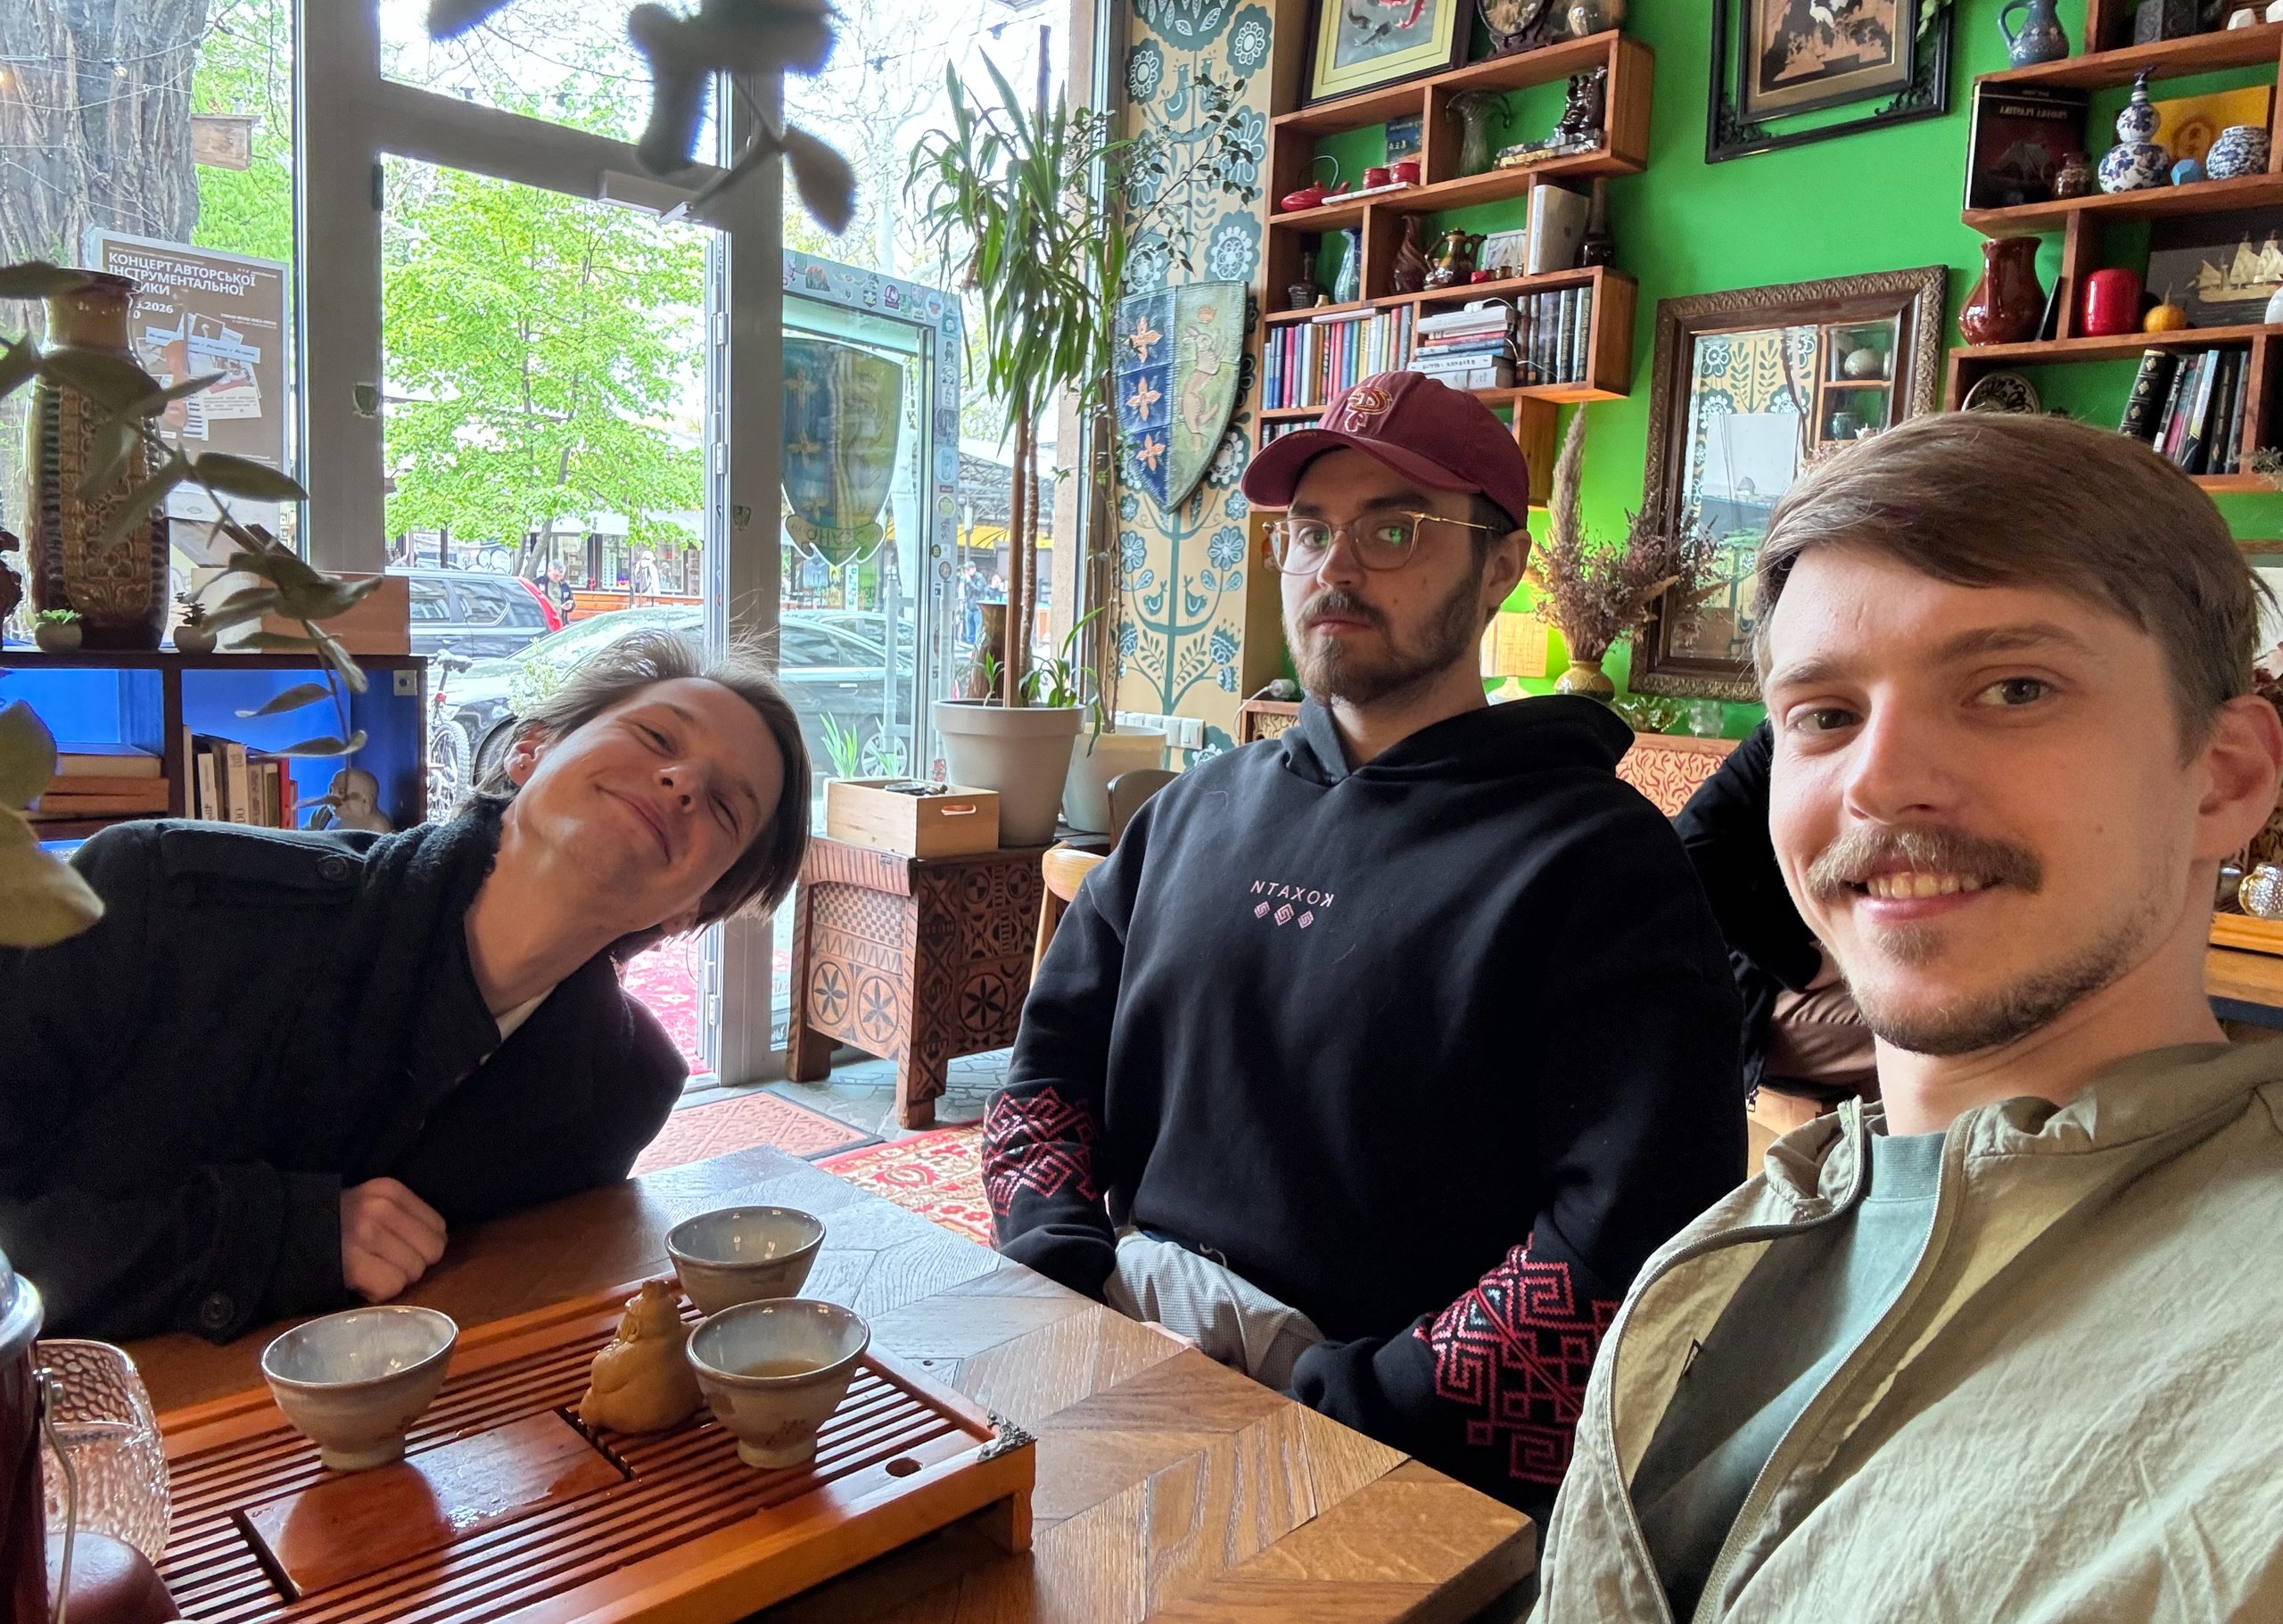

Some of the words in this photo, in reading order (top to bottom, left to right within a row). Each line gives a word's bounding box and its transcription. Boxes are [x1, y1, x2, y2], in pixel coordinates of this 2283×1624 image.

[108, 251, 173, 273] КОНЦЕРТ
[173, 264, 256, 287] АВТОРСЬКОЇ
[108, 264, 244, 297] ІНСТРУМЕНТАЛЬНОЇ
[140, 282, 170, 296] ИКИ
